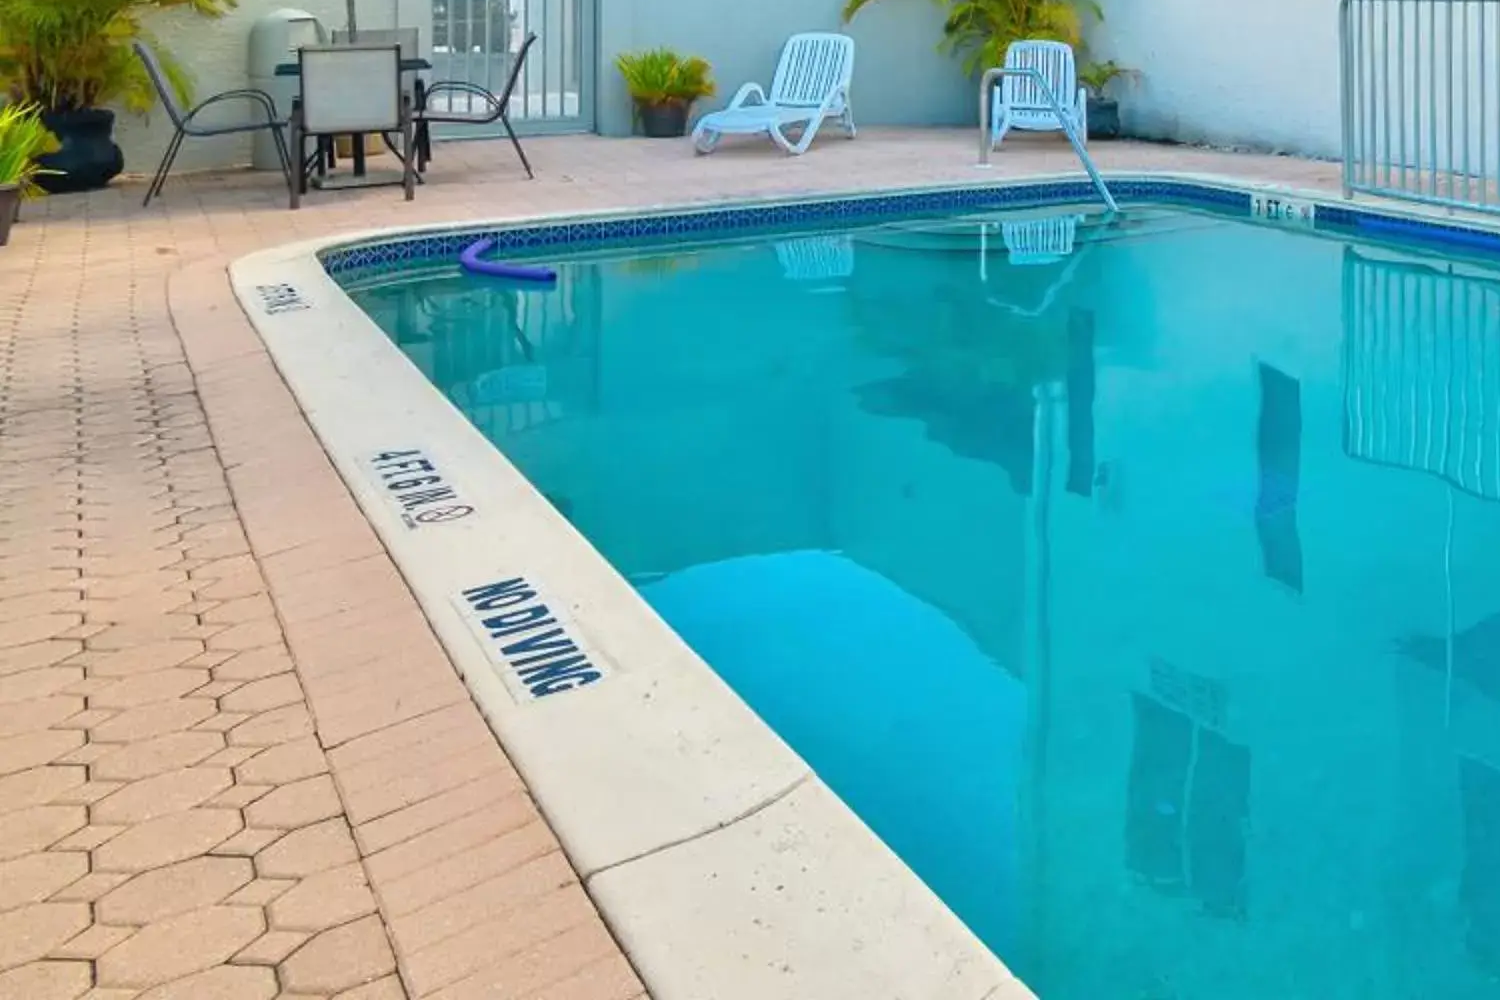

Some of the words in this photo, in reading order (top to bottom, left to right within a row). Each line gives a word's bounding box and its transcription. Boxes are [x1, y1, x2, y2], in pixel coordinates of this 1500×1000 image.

[371, 449, 421, 462] 4
[387, 475, 442, 491] 6
[461, 576, 538, 612] NO
[480, 603, 603, 698] DIVING
